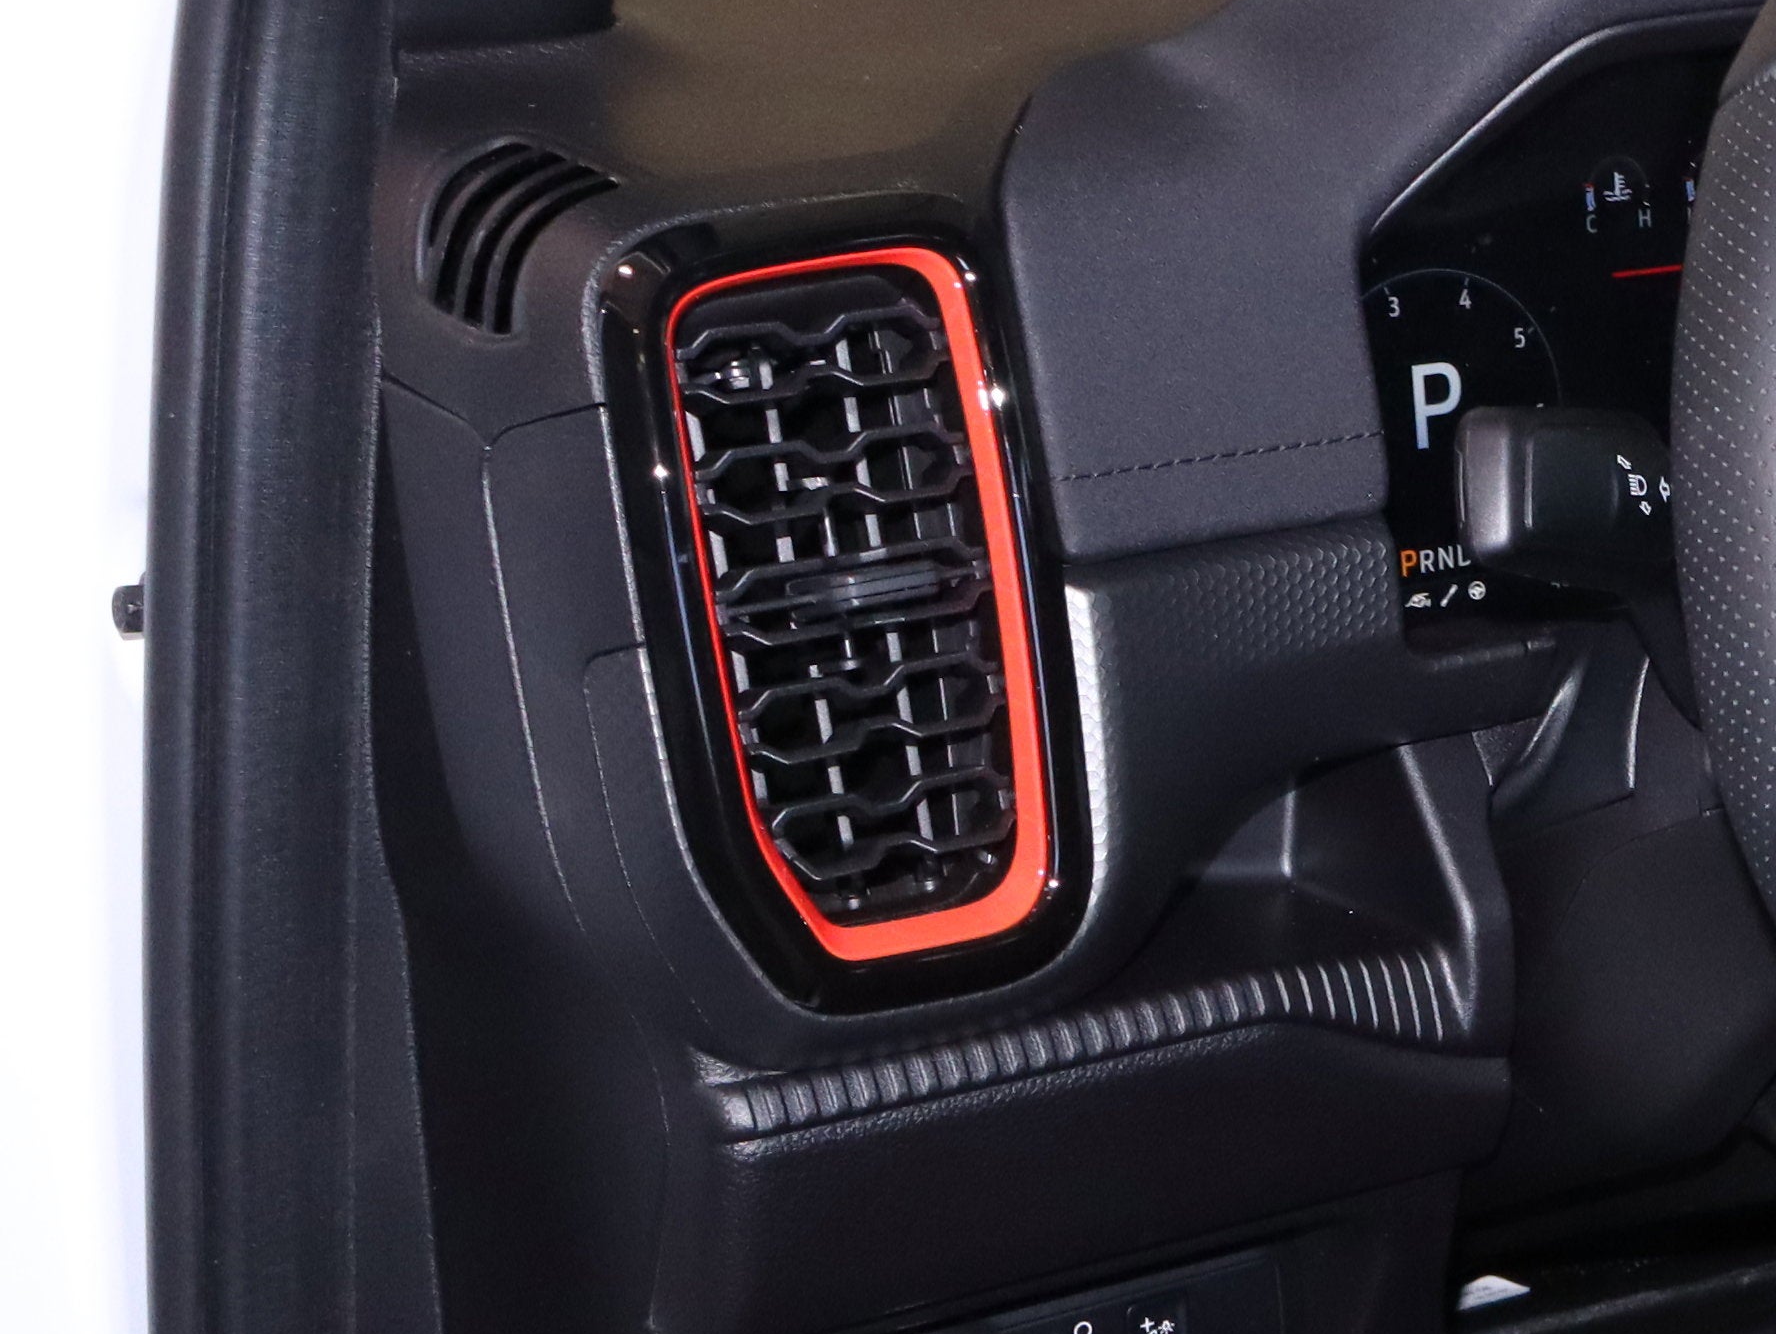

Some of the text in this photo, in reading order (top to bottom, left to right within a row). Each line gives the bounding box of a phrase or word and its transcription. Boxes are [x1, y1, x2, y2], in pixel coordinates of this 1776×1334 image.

[1637, 208, 1651, 227] H
[1387, 296, 1400, 317] 3
[1458, 289, 1471, 309] 4
[1513, 327, 1526, 348] 5
[1410, 361, 1462, 449] P
